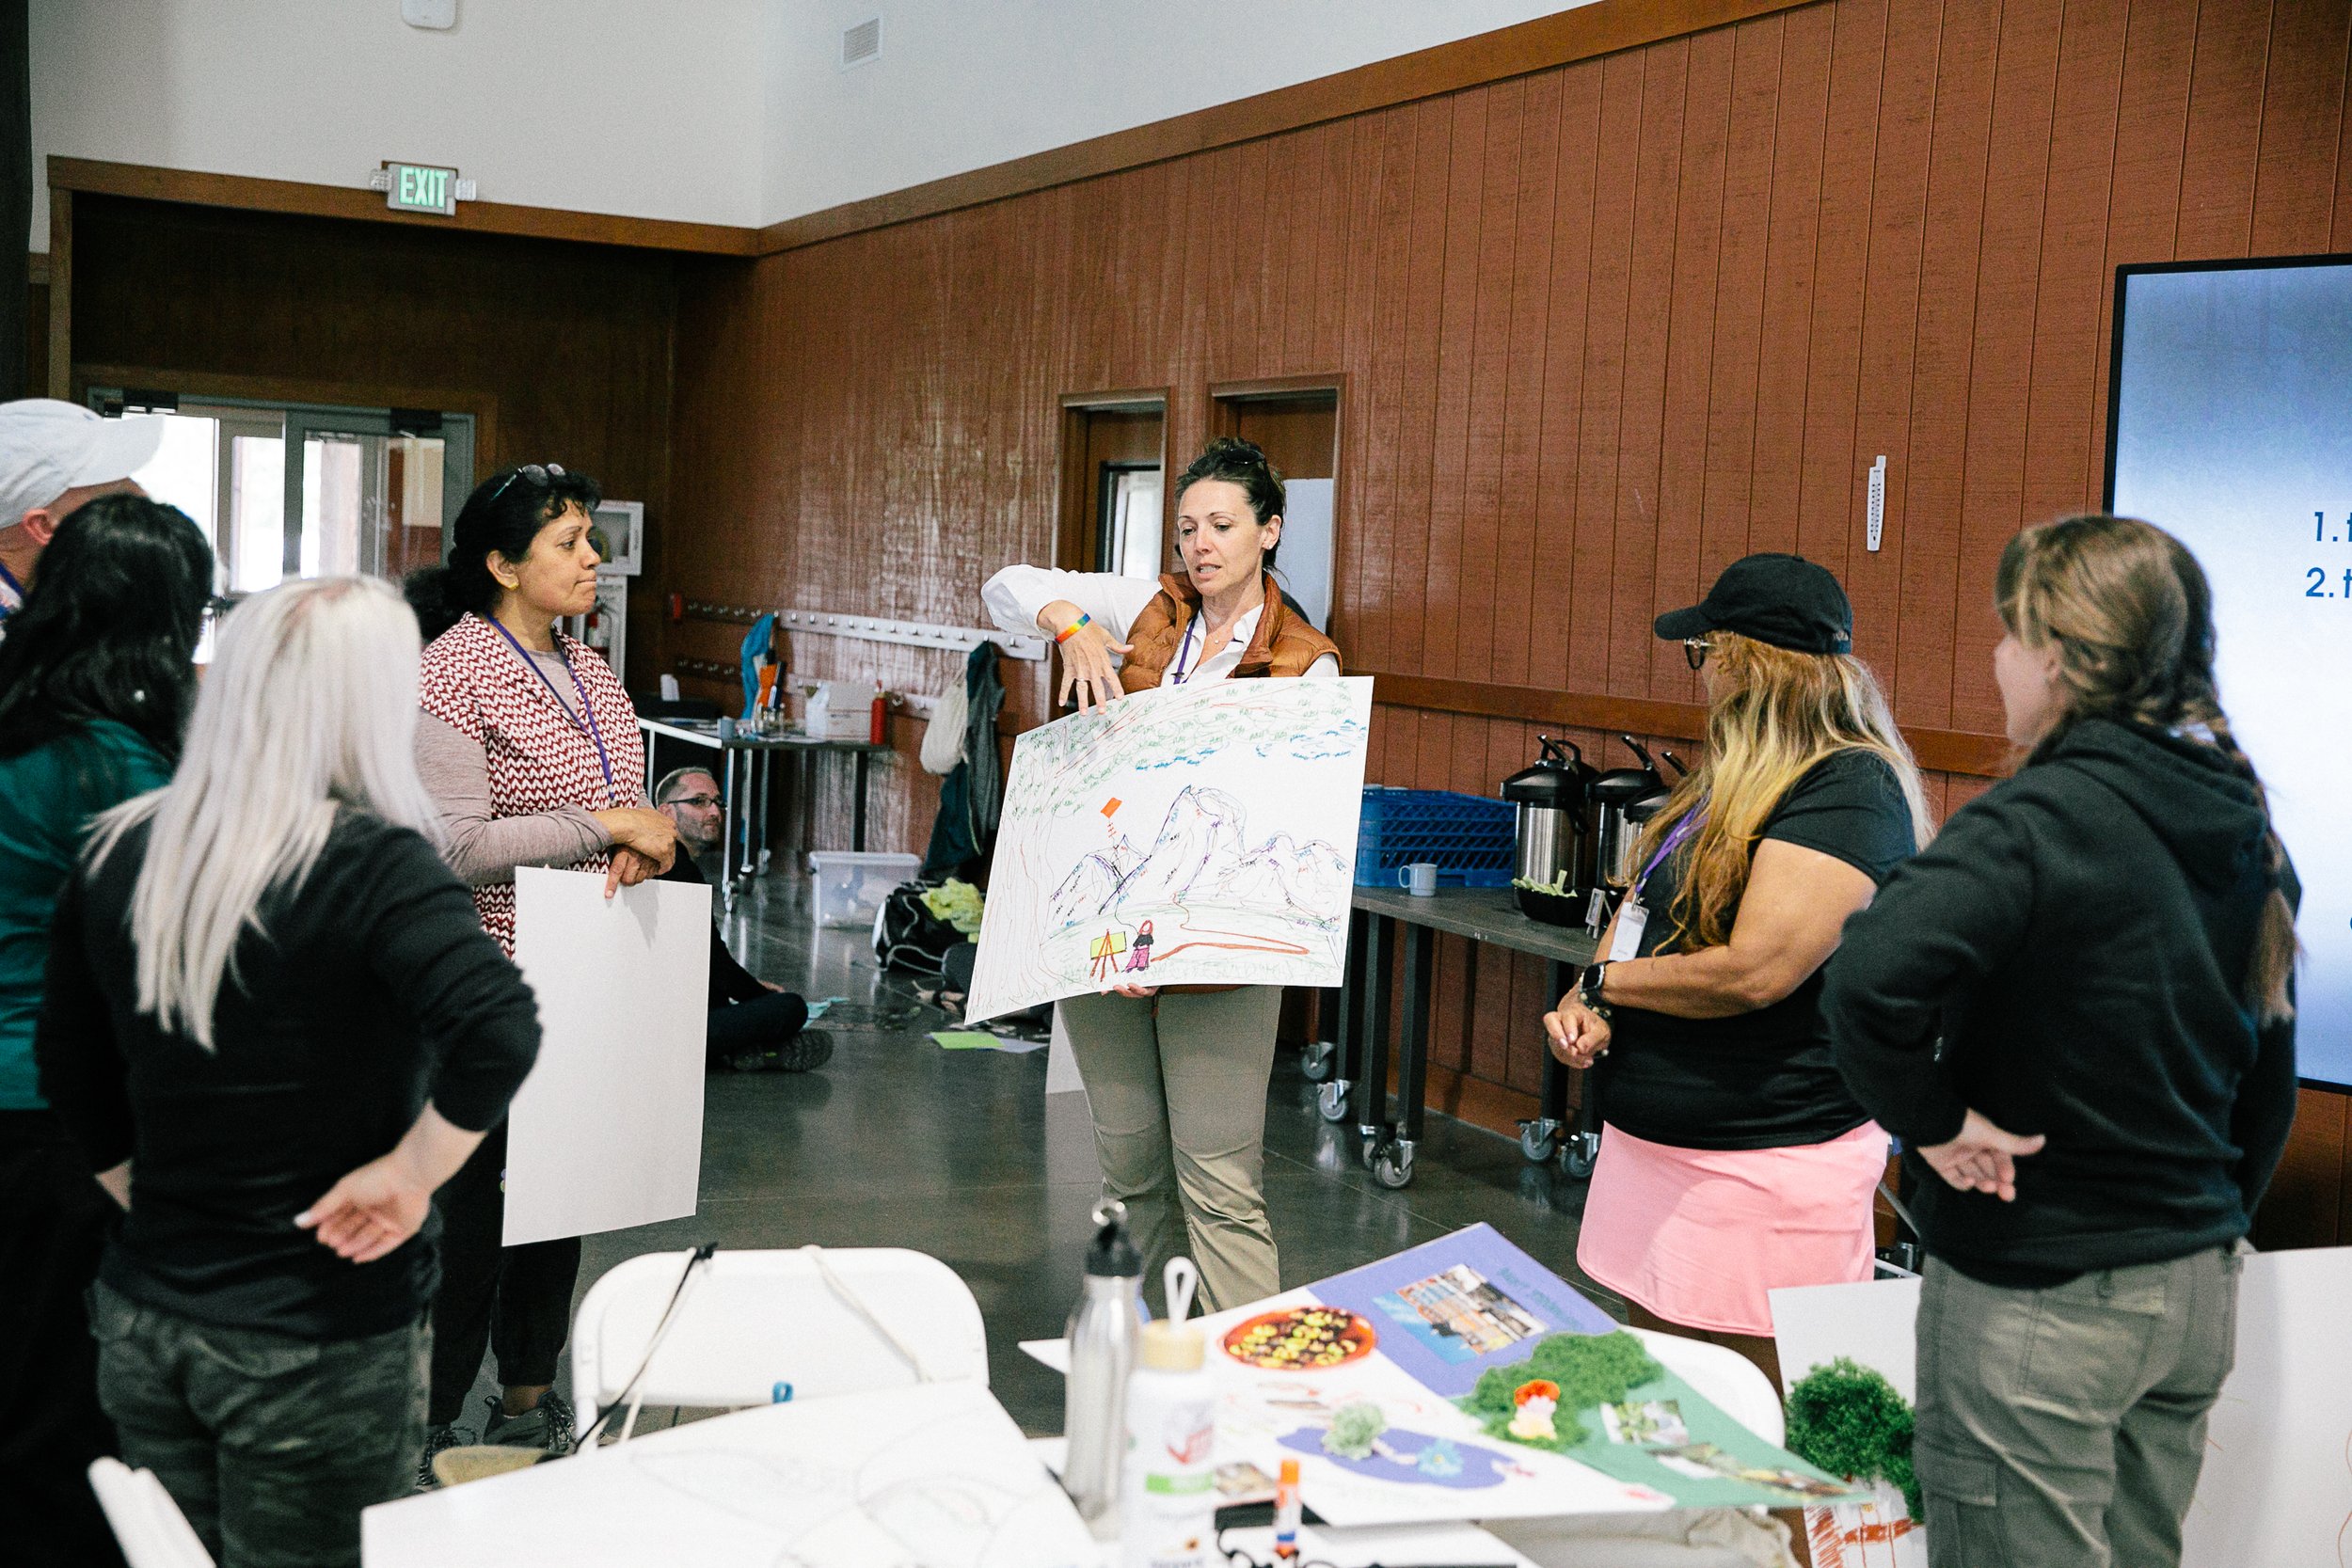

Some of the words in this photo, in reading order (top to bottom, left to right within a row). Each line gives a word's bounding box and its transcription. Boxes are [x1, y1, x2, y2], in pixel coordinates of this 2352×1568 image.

[399, 165, 449, 208] EXIT
[2314, 512, 2338, 542] 1.
[2306, 567, 2334, 597] 2.
